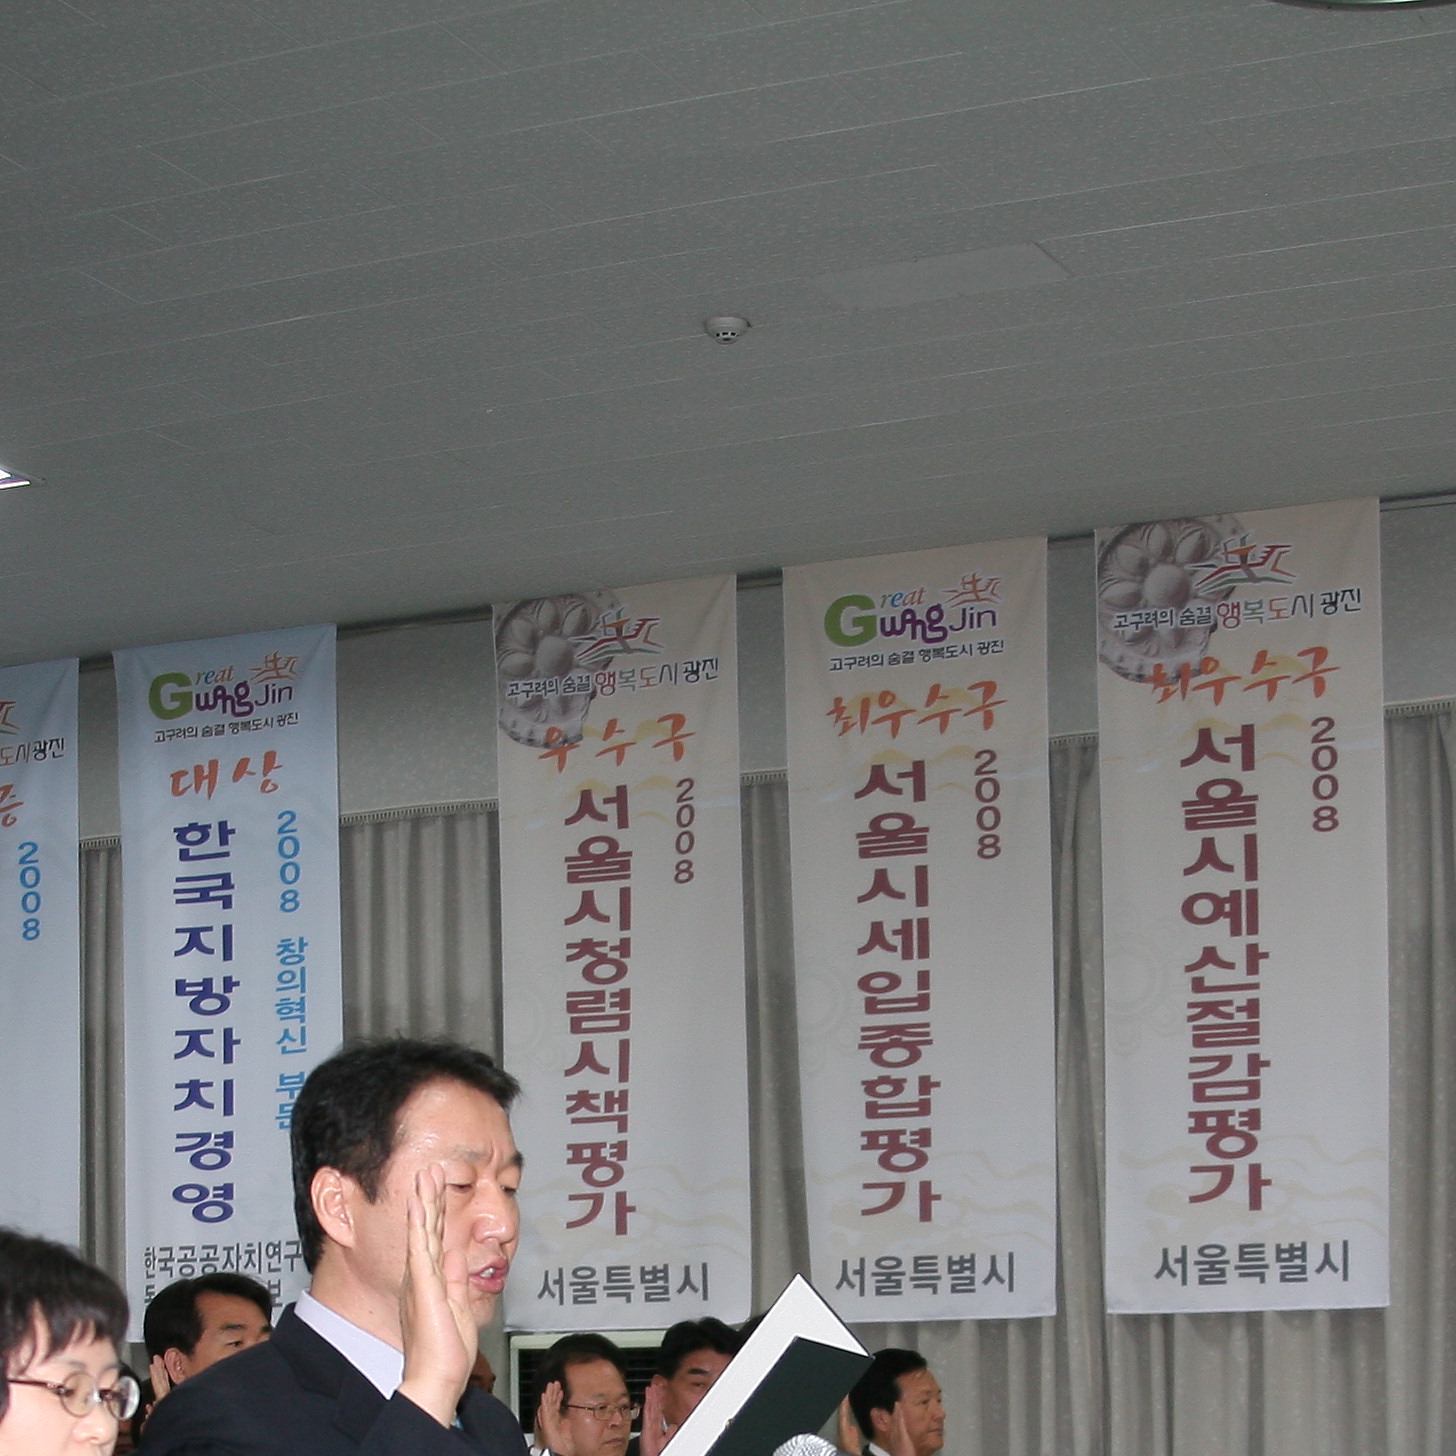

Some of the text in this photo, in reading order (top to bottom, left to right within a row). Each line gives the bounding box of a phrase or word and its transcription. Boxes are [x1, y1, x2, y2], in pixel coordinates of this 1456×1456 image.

[1114, 588, 1361, 631] 고구려의 숨결 행복도시 광진
[507, 657, 719, 698] 고구려의 숨결 행복도시 광진
[829, 640, 1004, 671] 고구려의 숨결 행복도시 광진
[33, 737, 65, 760] 광진
[538, 713, 696, 773] 우수구
[826, 680, 1009, 740] 최우수구
[170, 749, 283, 800] 대상
[974, 749, 1002, 859] 2008
[1310, 716, 1340, 833] 2008
[276, 810, 301, 913] 2008
[674, 777, 695, 884] 2008
[17, 840, 41, 942] 2008
[275, 936, 309, 1056] 창의혁신
[854, 760, 942, 1222] 서울시세입종합평가
[1180, 724, 1272, 1211] 서울시예산절감평가
[172, 820, 241, 1223] 한국지방자치경영
[564, 785, 637, 1236] 서울시청렴시책평가
[537, 1262, 708, 1306] 서울특별시
[835, 1252, 1014, 1297] 서울특별시
[1154, 1239, 1349, 1286] 서울특별시
